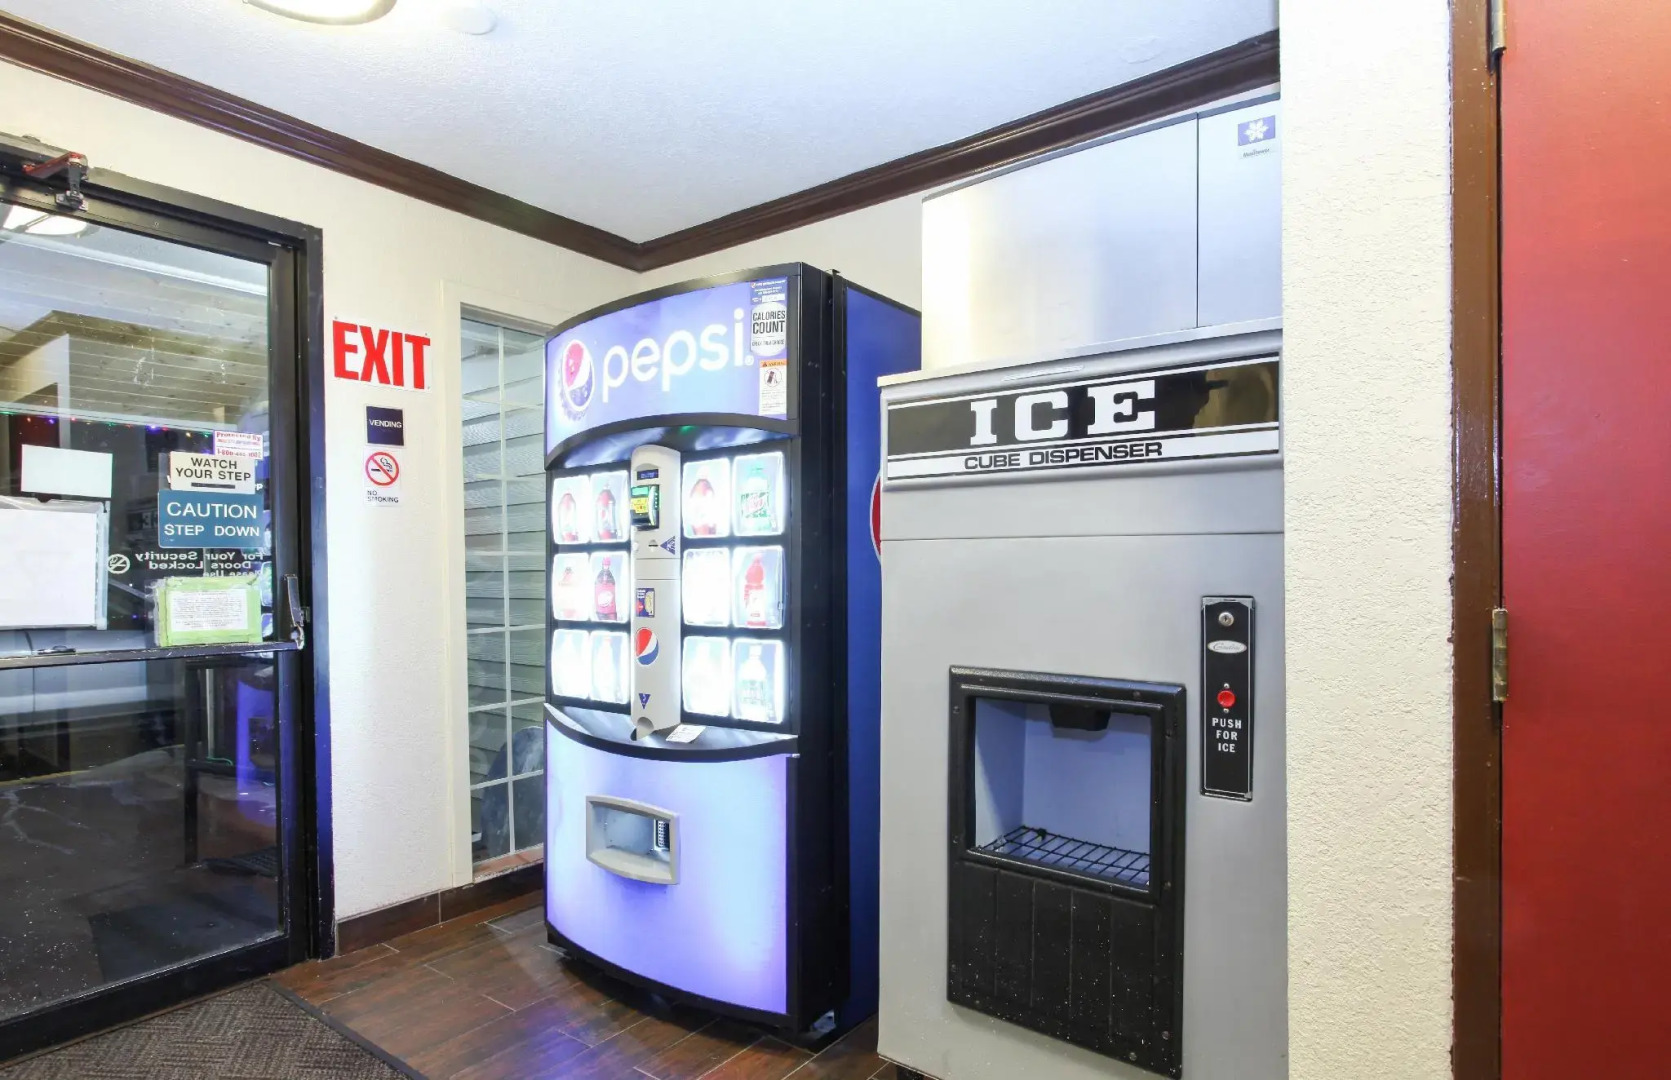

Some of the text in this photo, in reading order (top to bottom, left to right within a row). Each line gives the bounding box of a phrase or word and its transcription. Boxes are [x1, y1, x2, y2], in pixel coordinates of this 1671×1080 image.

[752, 310, 786, 322] CALORIES
[752, 320, 786, 335] COUNT
[332, 319, 431, 390] EXIT
[602, 307, 744, 403] pepsi
[969, 379, 1156, 447] ICE
[368, 419, 402, 428] VENDING
[964, 441, 1163, 471] CUBE DISPENSER
[190, 457, 238, 470] WATCH
[175, 467, 213, 480] YOUR
[218, 470, 252, 481] STEP
[166, 501, 257, 519] CAUTION
[164, 523, 260, 537] STEP DOWN
[1211, 717, 1242, 729] PUSH
[1215, 729, 1238, 741] FOR
[1217, 743, 1236, 753] ICE
